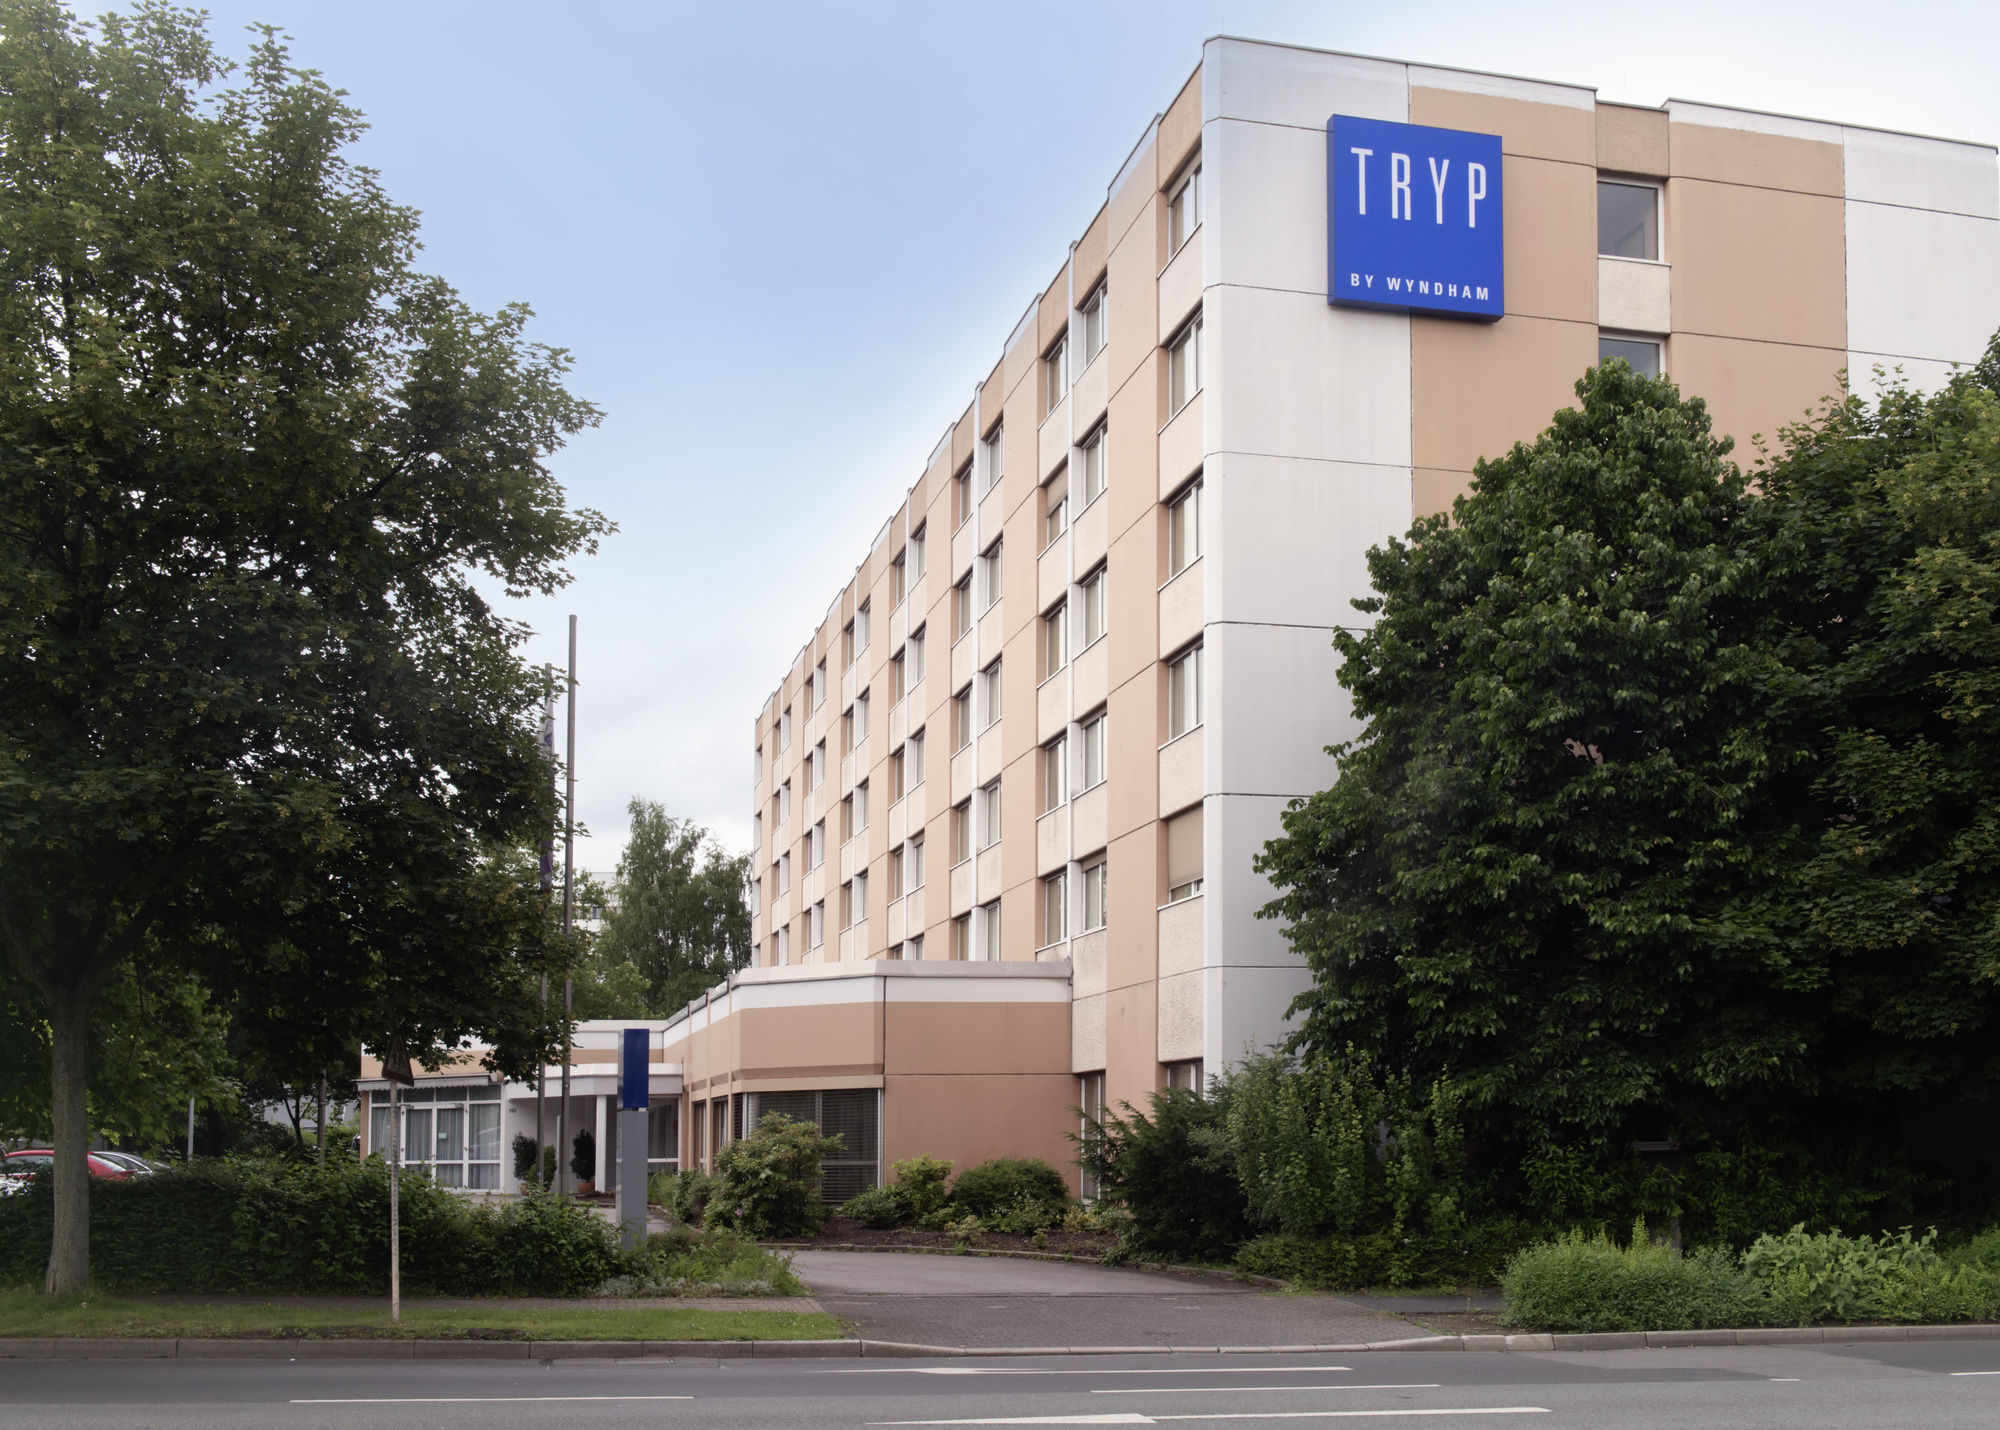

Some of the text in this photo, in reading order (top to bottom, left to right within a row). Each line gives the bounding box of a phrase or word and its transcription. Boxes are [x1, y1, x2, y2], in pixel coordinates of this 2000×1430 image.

[1351, 147, 1487, 228] TRYP
[1351, 273, 1488, 300] BY WYNDHAM
